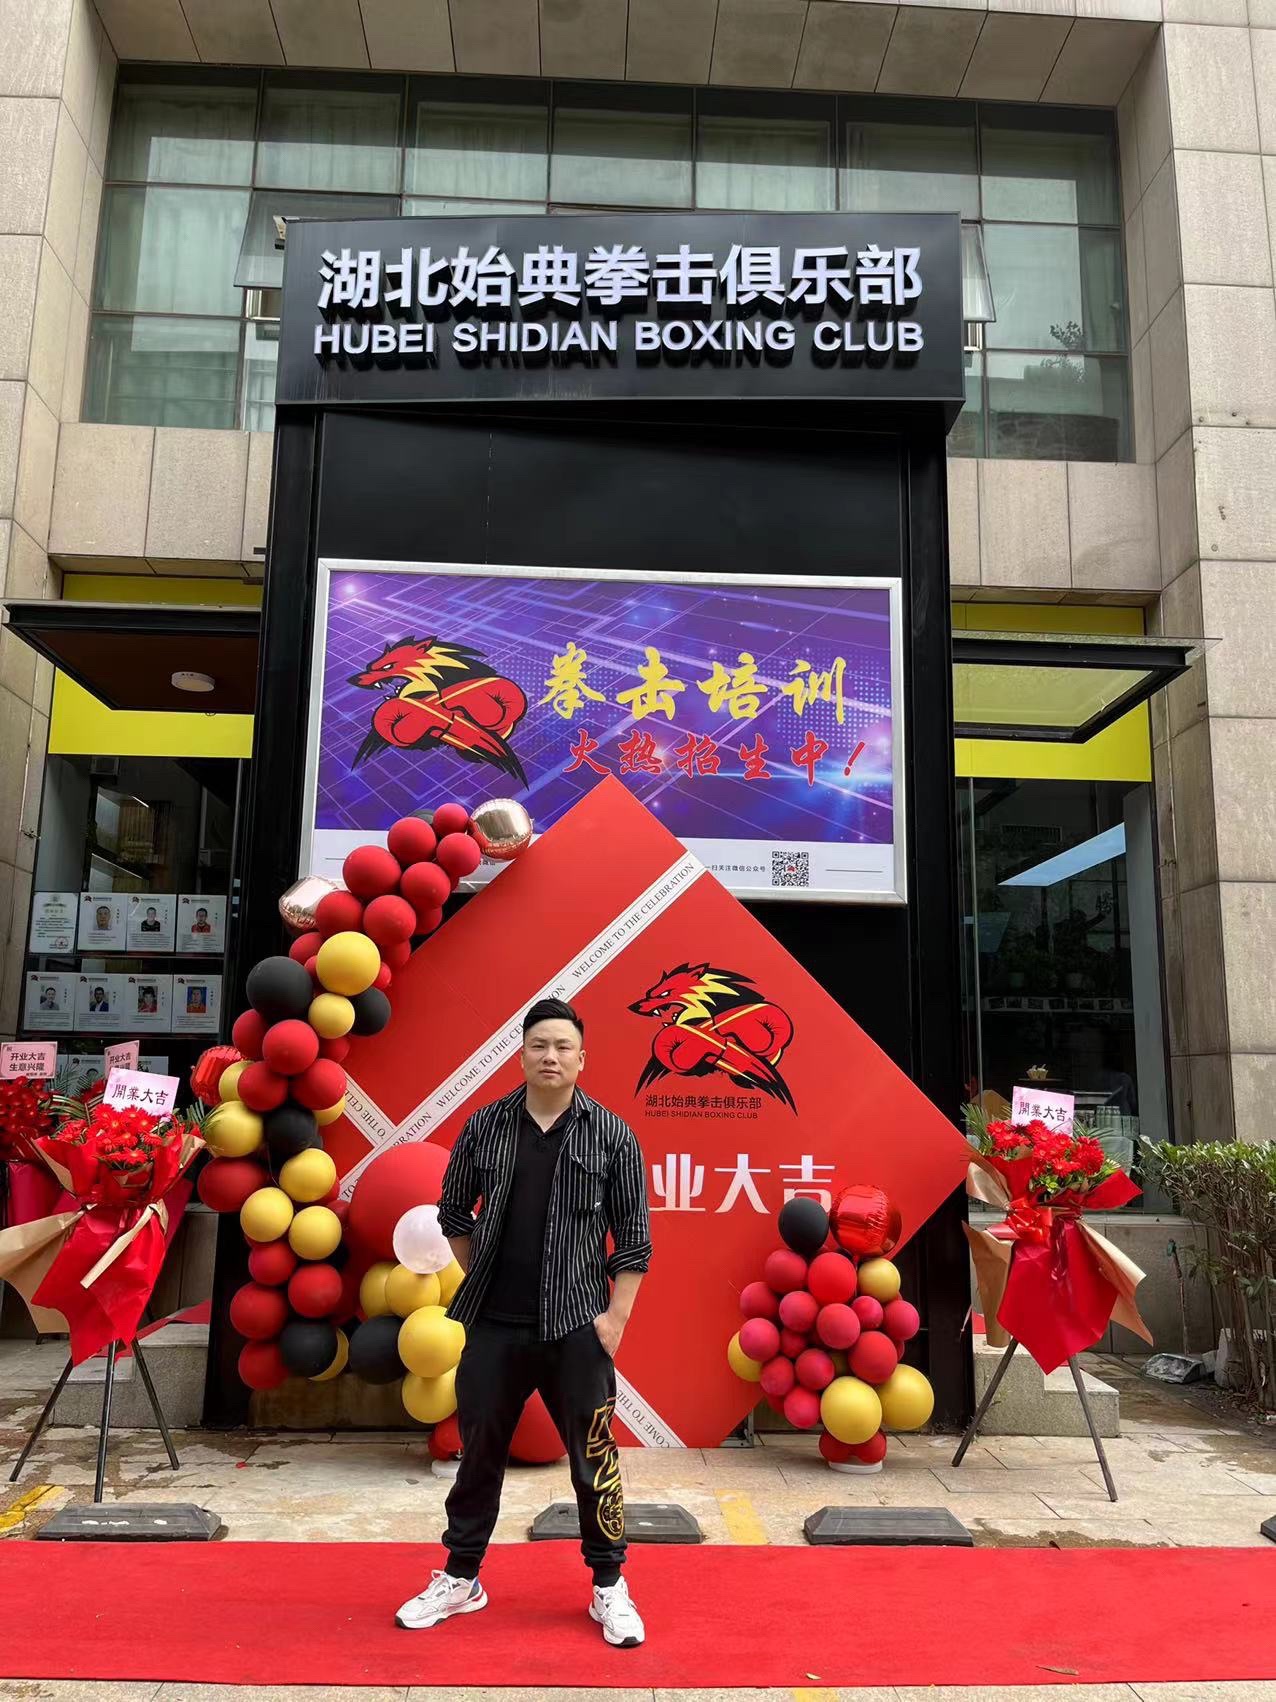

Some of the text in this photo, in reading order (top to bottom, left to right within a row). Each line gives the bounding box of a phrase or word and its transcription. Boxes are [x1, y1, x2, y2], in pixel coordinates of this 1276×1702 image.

[318, 244, 921, 309] 湖北始典拳击俱乐部
[314, 319, 925, 354] HUBEI SHIDIAN BOXING CLUB
[538, 642, 847, 724] 拳击培训
[436, 1065, 481, 1108] WELCOME
[479, 1056, 493, 1068] TO
[491, 1037, 511, 1057] THE
[572, 938, 615, 978] WELCOME
[611, 927, 626, 941] TO
[623, 912, 643, 930] THE
[640, 863, 695, 915] CELEBRATION
[10, 1052, 46, 1061] 开业大吉
[112, 1084, 169, 1106] 開業大吉
[645, 1095, 761, 1109] 湖北始典拳击俱乐部
[671, 1110, 702, 1118] SHIDIAN
[705, 1111, 735, 1119] BOXING
[1018, 1101, 1068, 1121] 開業大吉
[631, 1408, 645, 1425] TO
